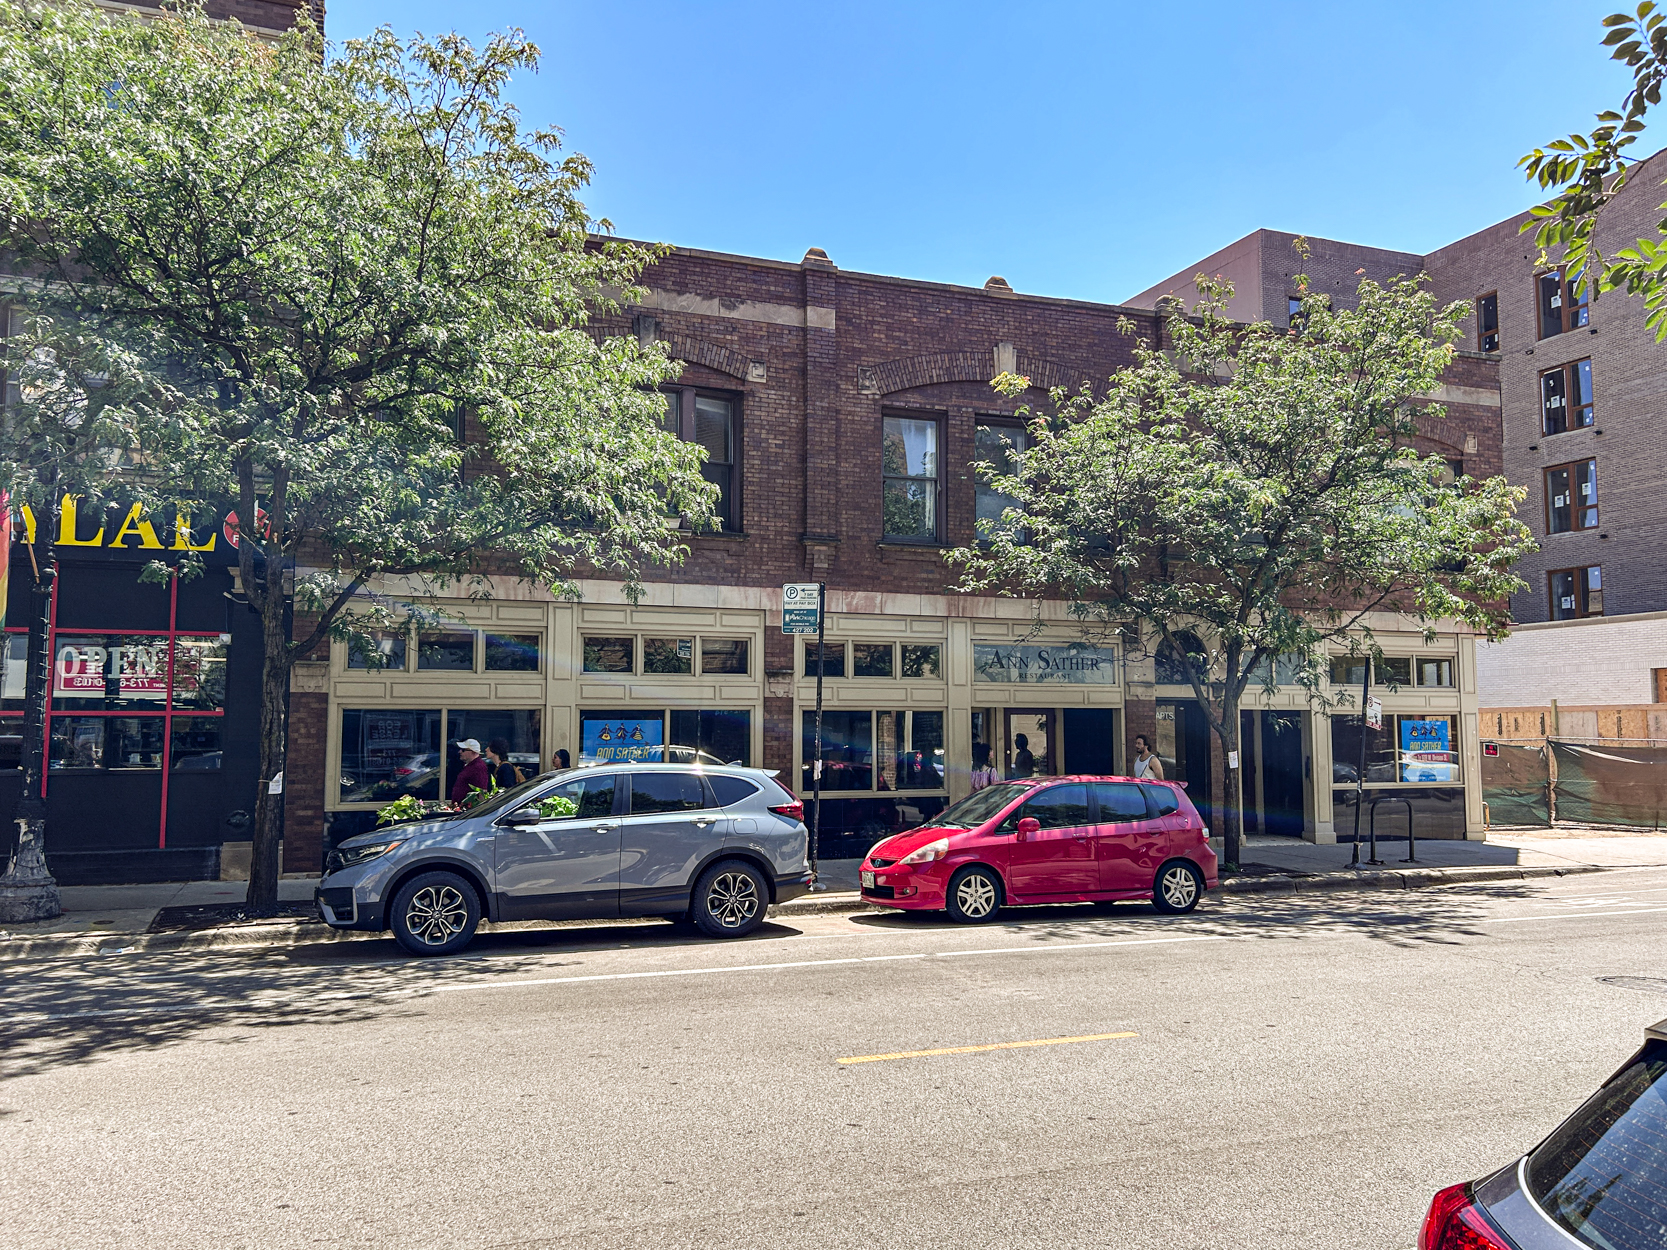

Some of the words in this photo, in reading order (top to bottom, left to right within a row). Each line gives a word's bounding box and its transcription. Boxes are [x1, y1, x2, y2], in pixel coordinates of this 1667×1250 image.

[1020, 672, 1071, 680] RESTAURANT
[596, 747, 614, 759] ANN
[615, 746, 651, 759] SATHER
